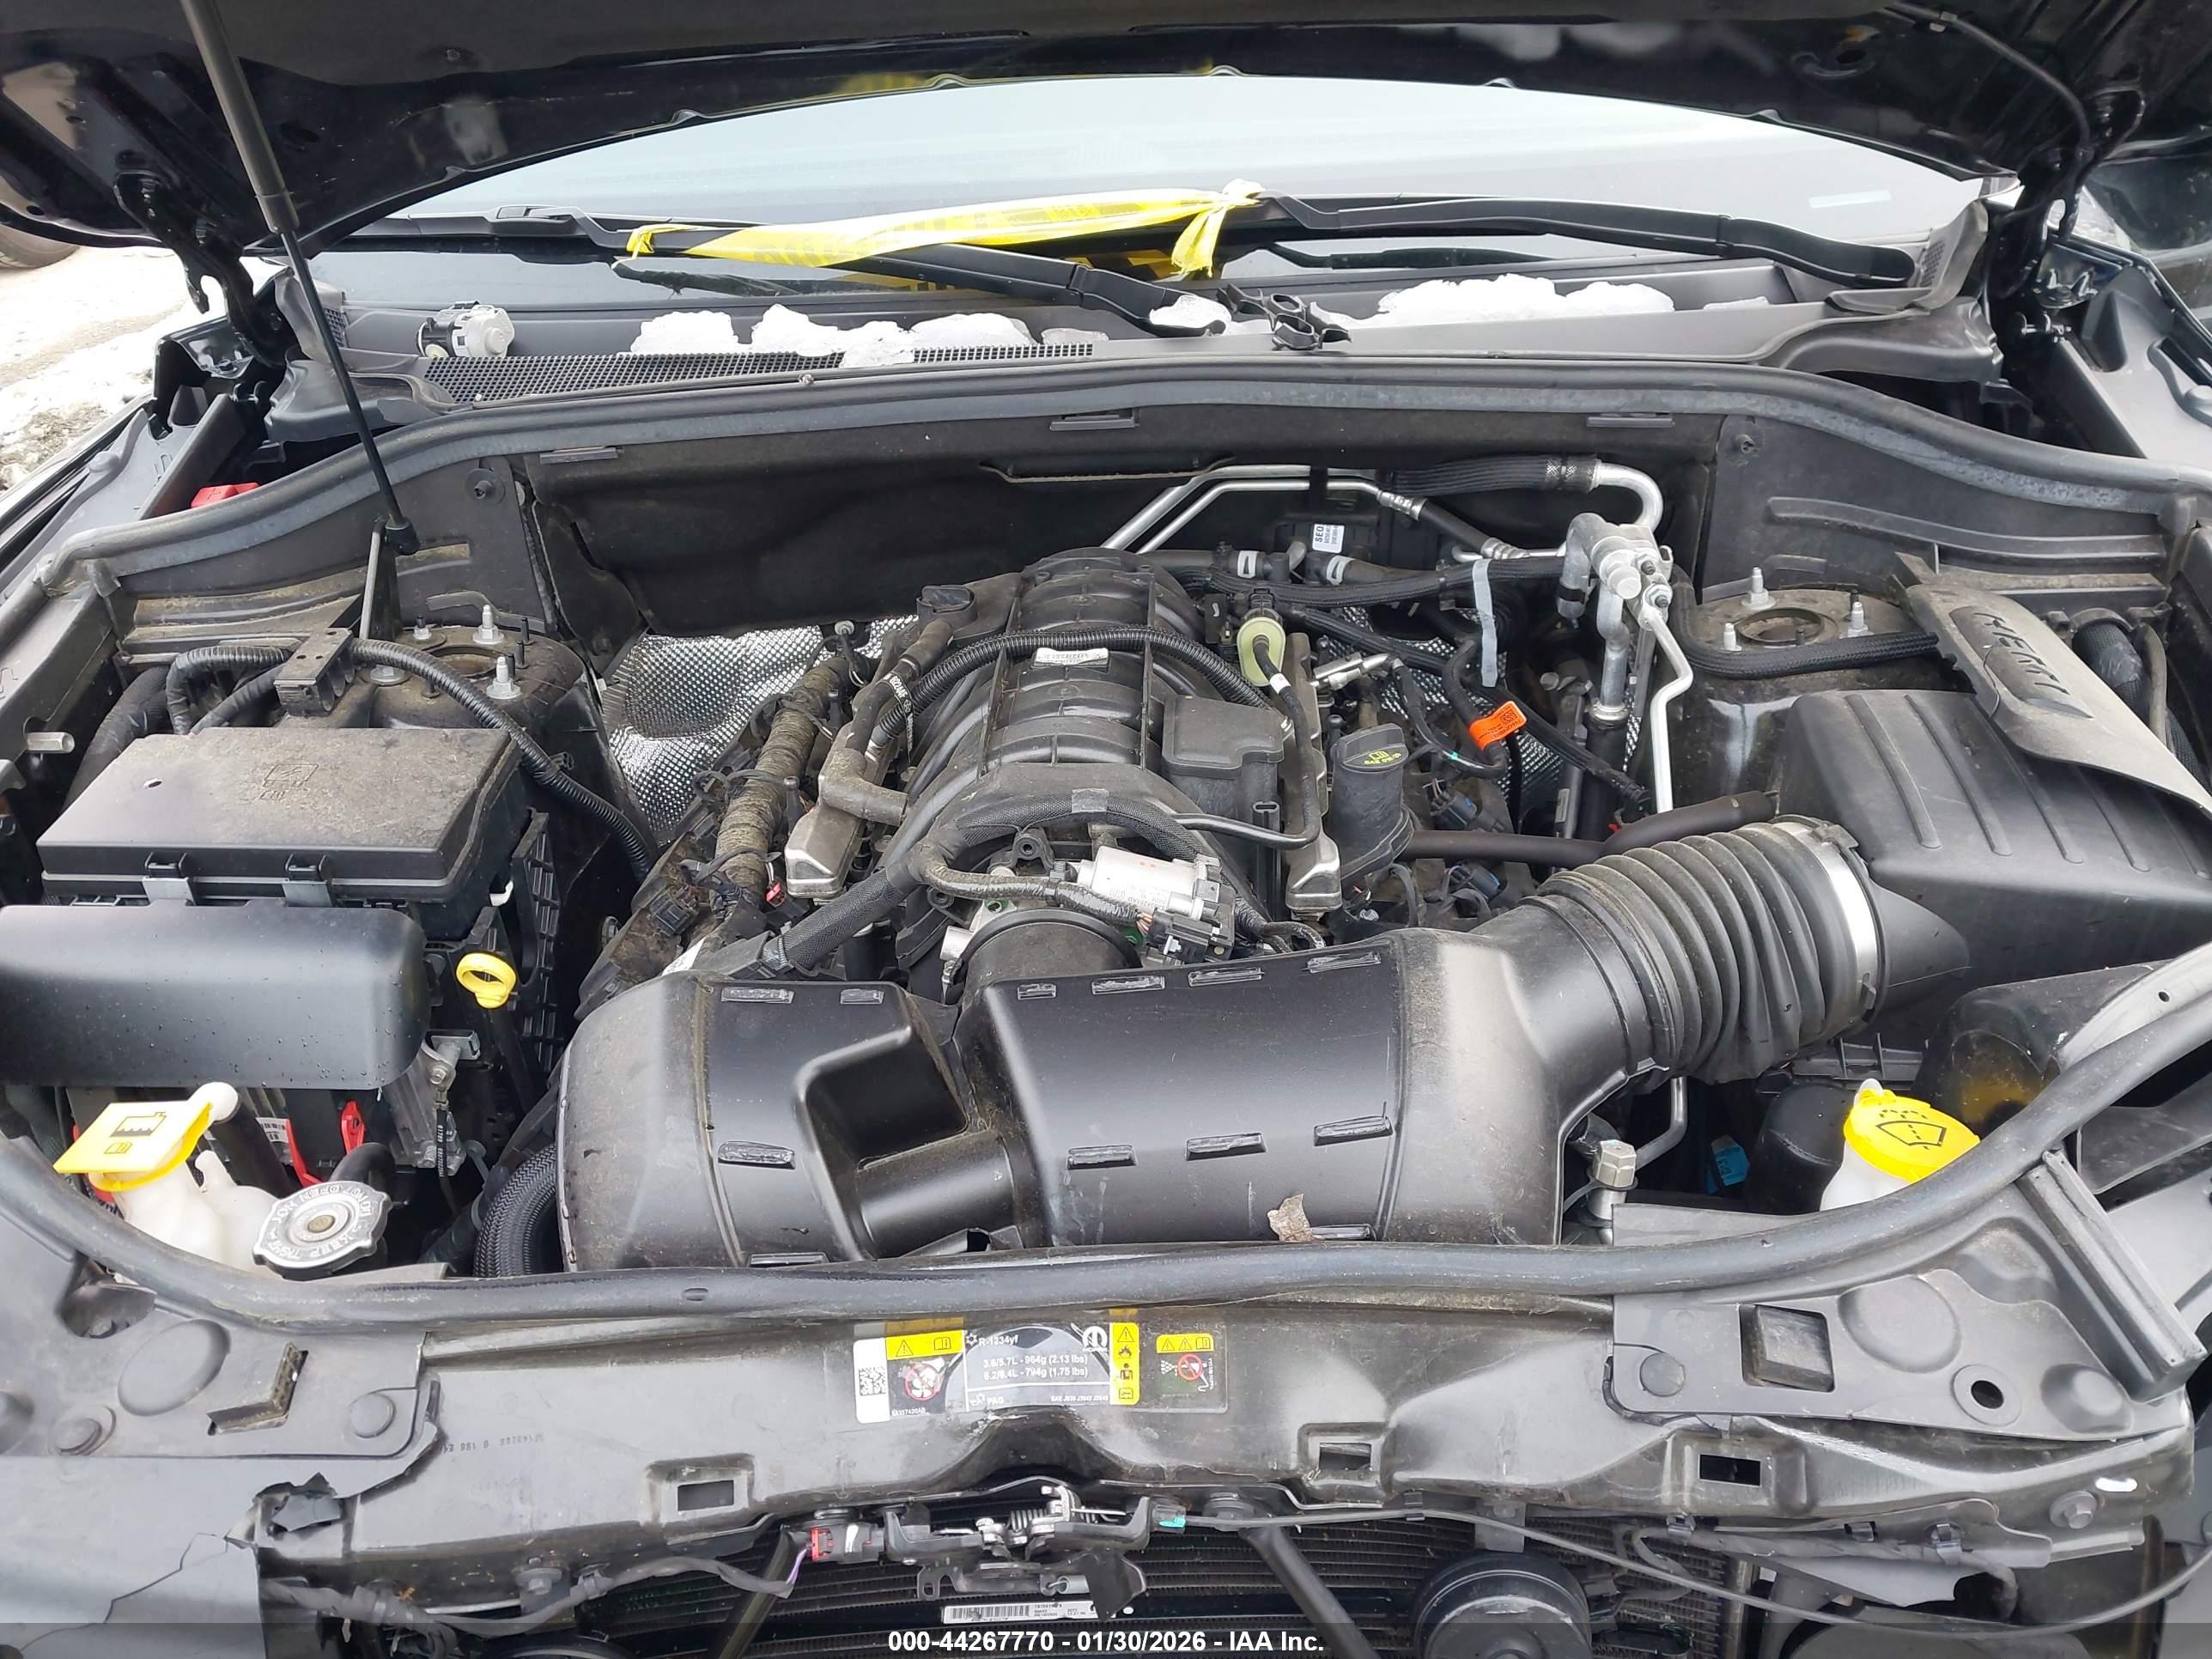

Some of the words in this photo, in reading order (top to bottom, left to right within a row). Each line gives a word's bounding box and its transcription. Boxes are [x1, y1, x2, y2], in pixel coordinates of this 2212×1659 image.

[1972, 611, 2071, 696] HEMI
[301, 1184, 343, 1201] OPEN
[978, 1334, 1018, 1347] R-1234yf
[1048, 1354, 1070, 1366] (2.13
[1071, 1353, 1088, 1365] lbs)
[1025, 1368, 1047, 1379] 794g
[1048, 1366, 1070, 1378] (1.75
[1072, 1365, 1088, 1377] lbs)
